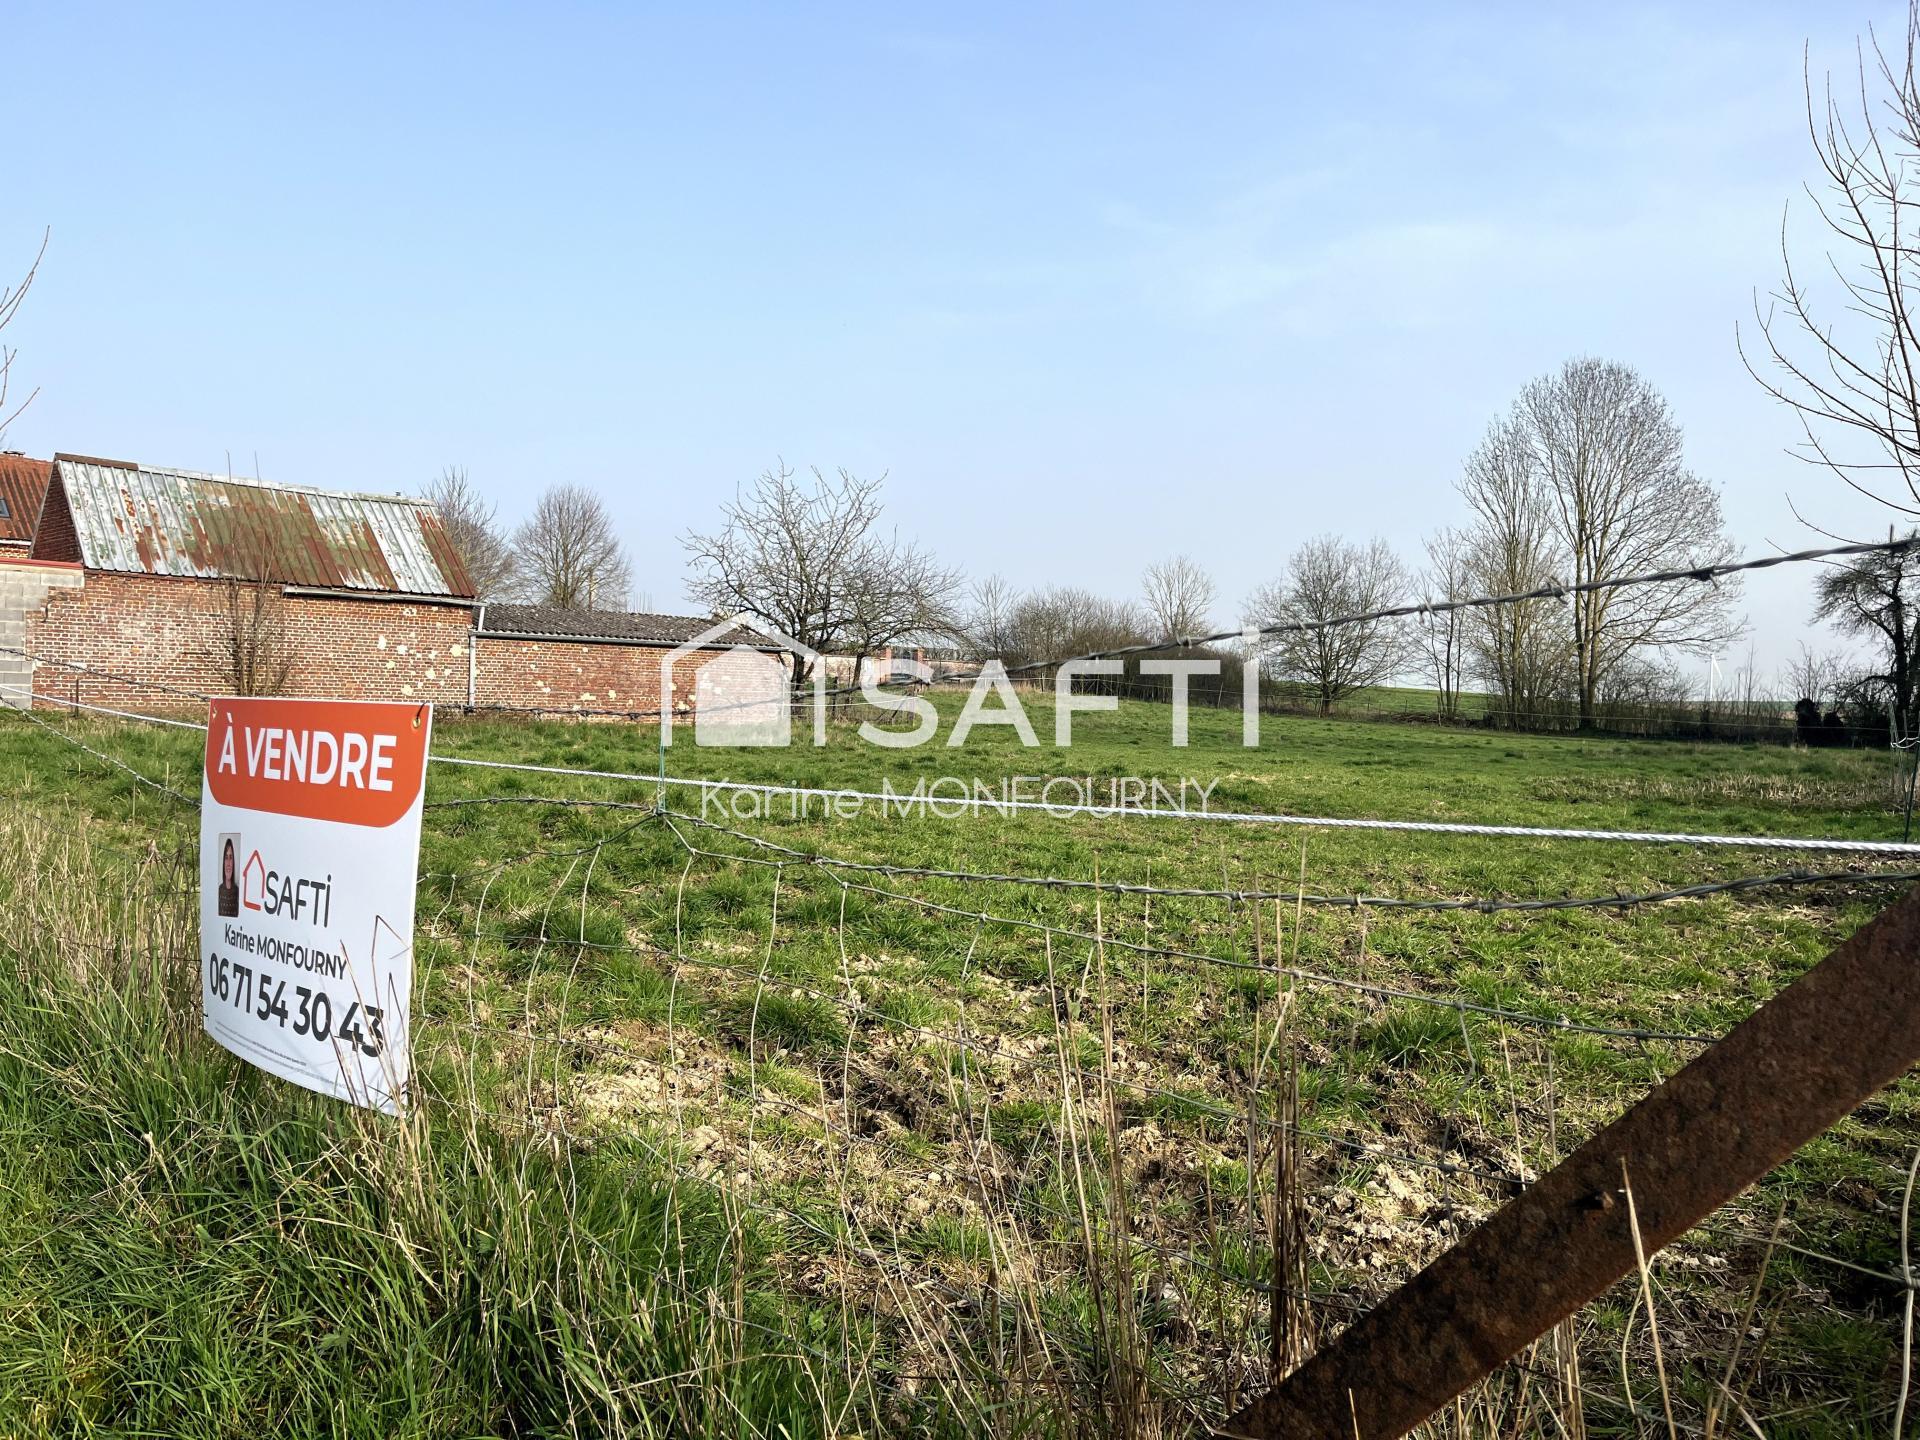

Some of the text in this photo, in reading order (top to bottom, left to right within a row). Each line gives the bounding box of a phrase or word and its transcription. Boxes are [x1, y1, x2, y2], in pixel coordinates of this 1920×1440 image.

[218, 711, 398, 792] À VENDRE
[224, 922, 348, 980] Karine MONFOURNY
[209, 952, 230, 1002] 06
[233, 963, 253, 1014] 71
[256, 973, 289, 1028] 54
[292, 985, 332, 1042] 30
[338, 1001, 384, 1058] 43
